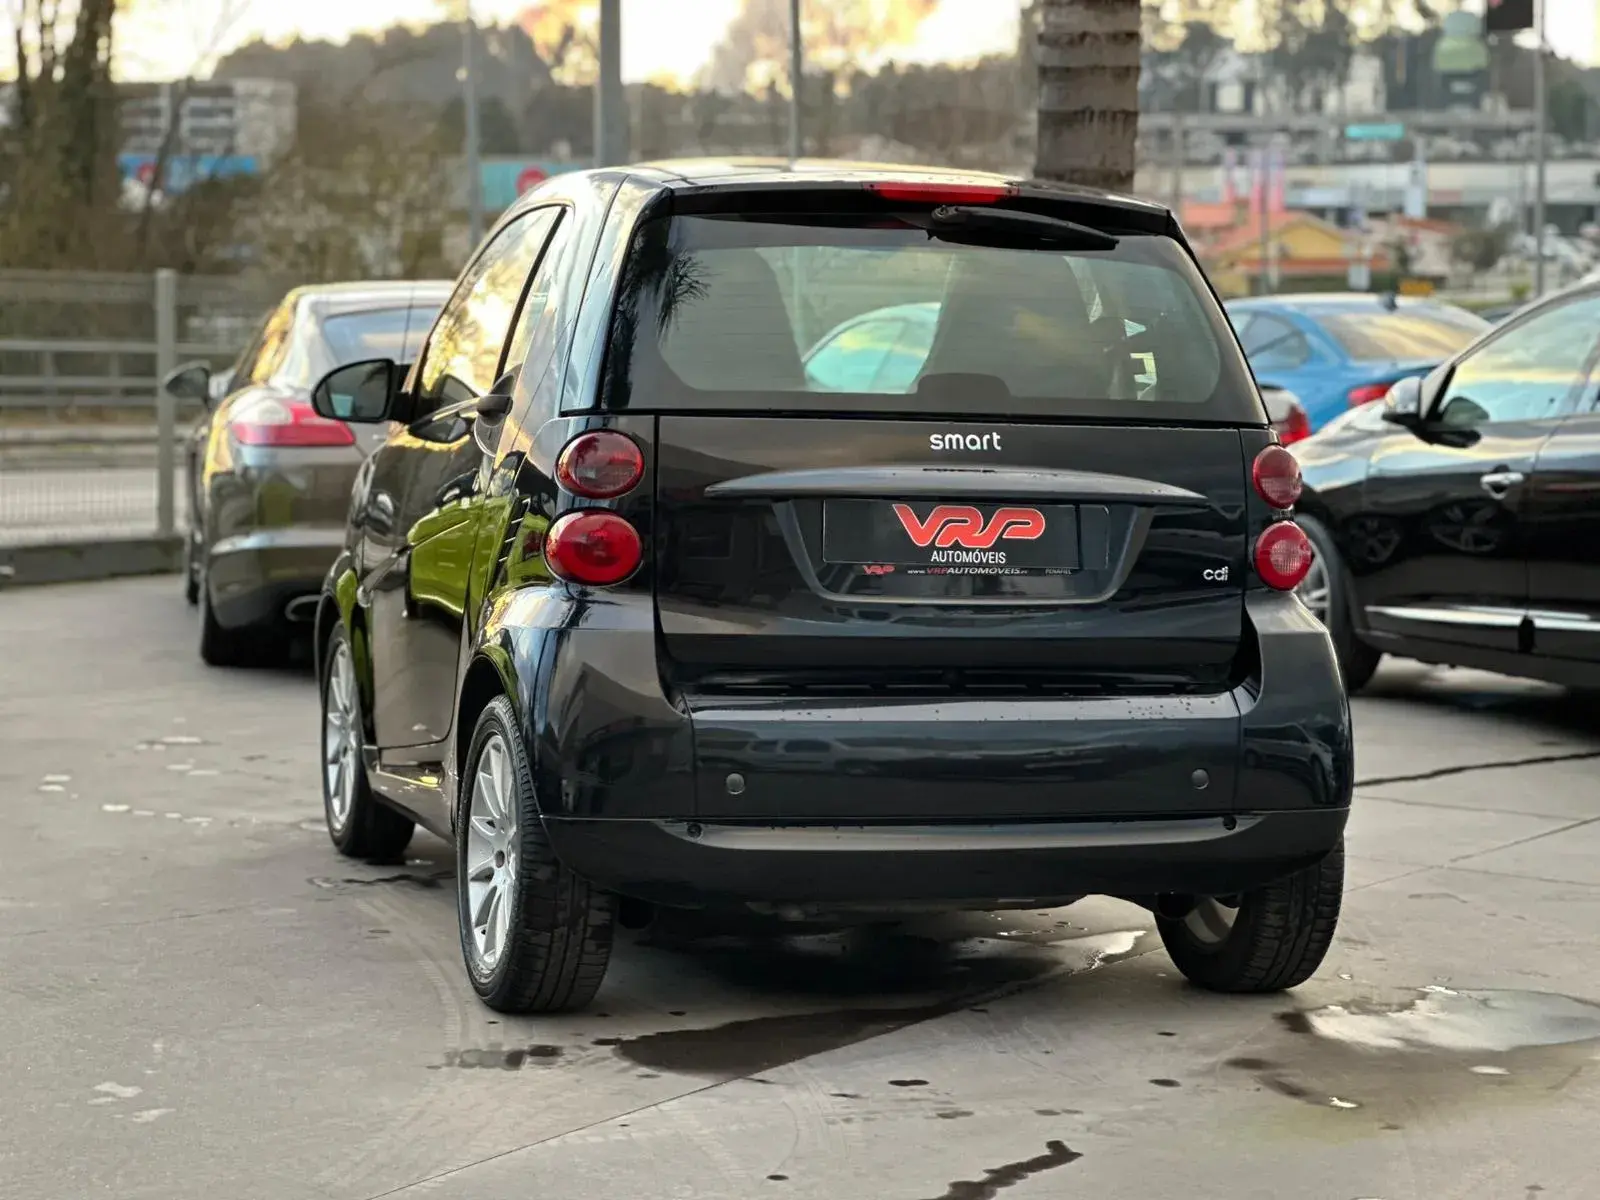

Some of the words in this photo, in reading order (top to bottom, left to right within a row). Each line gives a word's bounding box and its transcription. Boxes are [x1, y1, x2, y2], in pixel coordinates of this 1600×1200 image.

[929, 432, 1002, 450] smart
[892, 504, 1046, 548] VRP
[931, 549, 1006, 563] AUTOMÓVEIS
[1203, 566, 1229, 581] cdi
